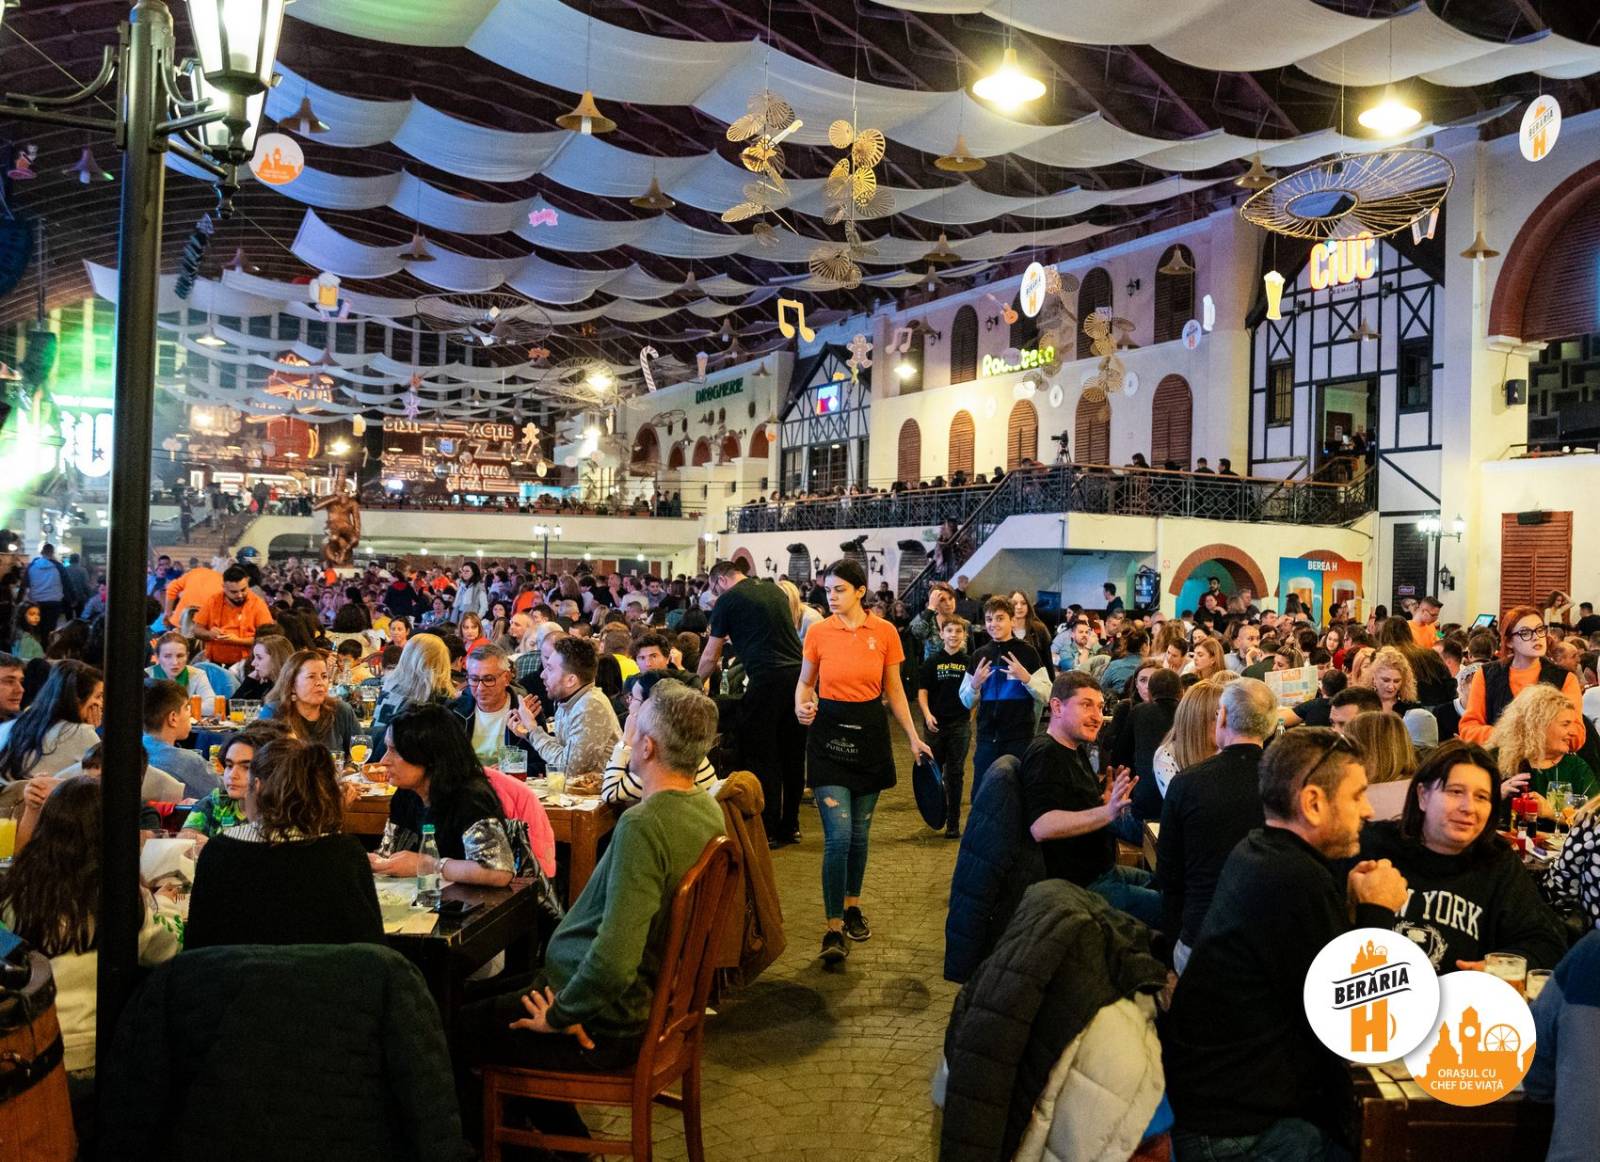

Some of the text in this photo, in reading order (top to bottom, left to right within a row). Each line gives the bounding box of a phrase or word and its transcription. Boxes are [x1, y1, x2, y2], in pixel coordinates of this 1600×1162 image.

[1307, 560, 1338, 571] BEREA H
[1422, 890, 1483, 941] YORK
